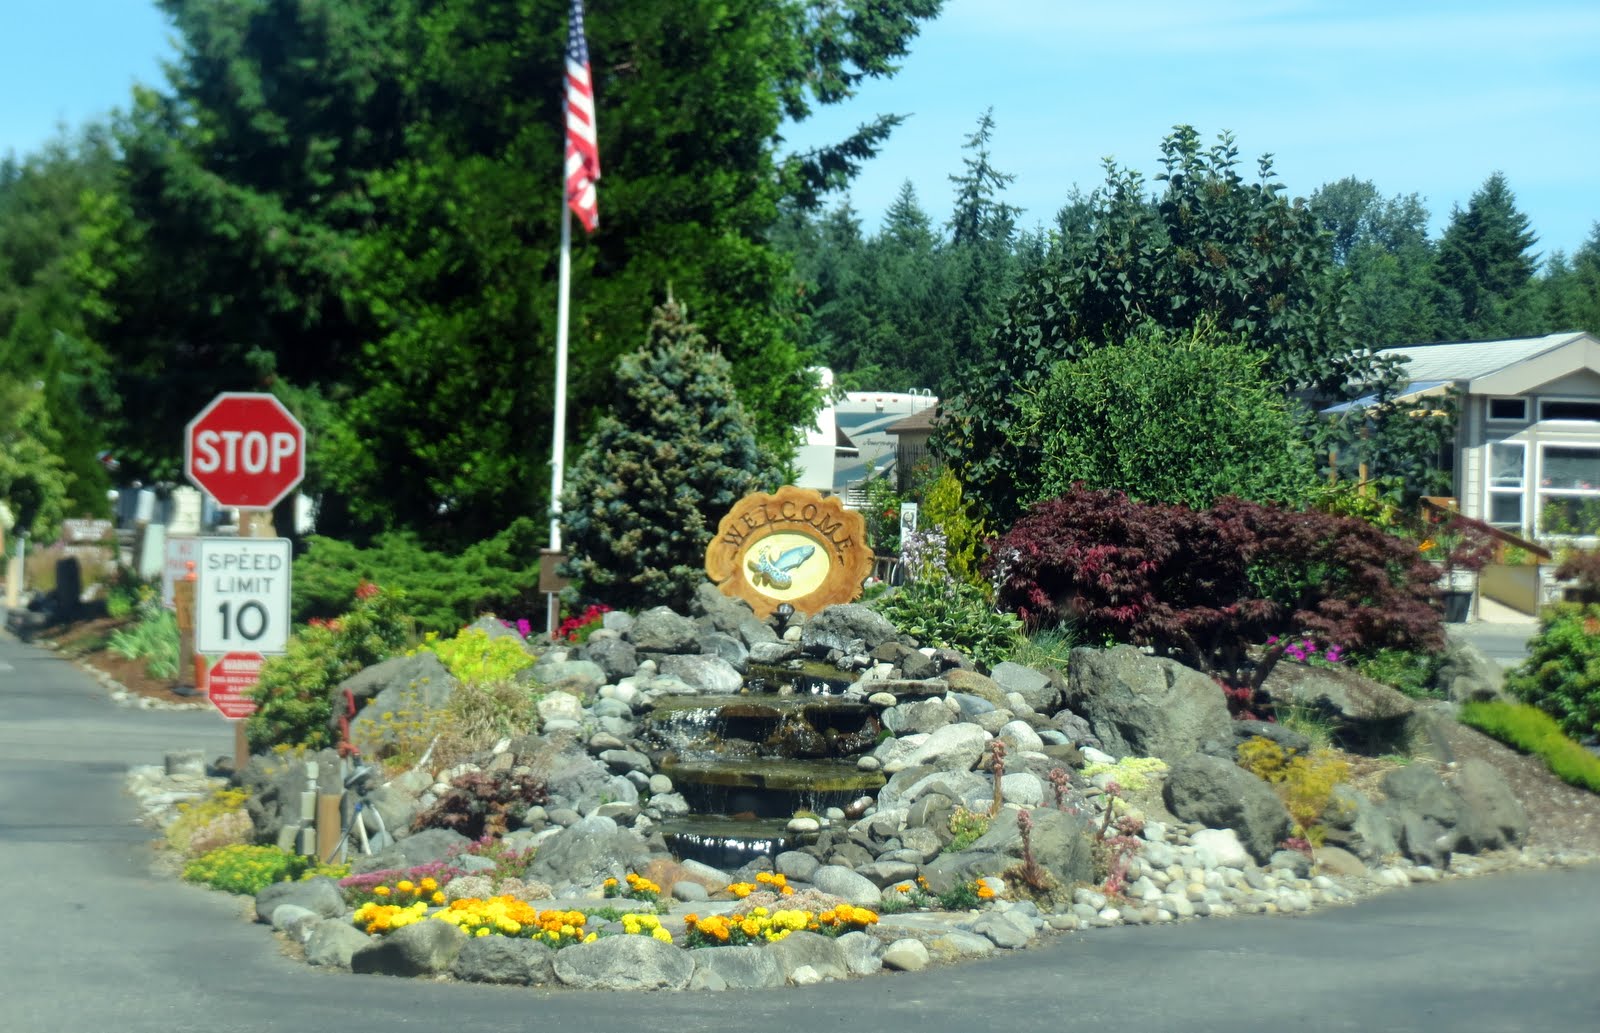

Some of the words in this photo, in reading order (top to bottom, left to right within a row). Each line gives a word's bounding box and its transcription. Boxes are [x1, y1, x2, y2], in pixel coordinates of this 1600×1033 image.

[196, 430, 296, 474] STOP
[722, 500, 854, 552] WELCOME
[208, 553, 282, 570] SPEED
[216, 576, 274, 592] LIMIT
[218, 600, 270, 640] 10
[223, 659, 264, 670] WARNIN
